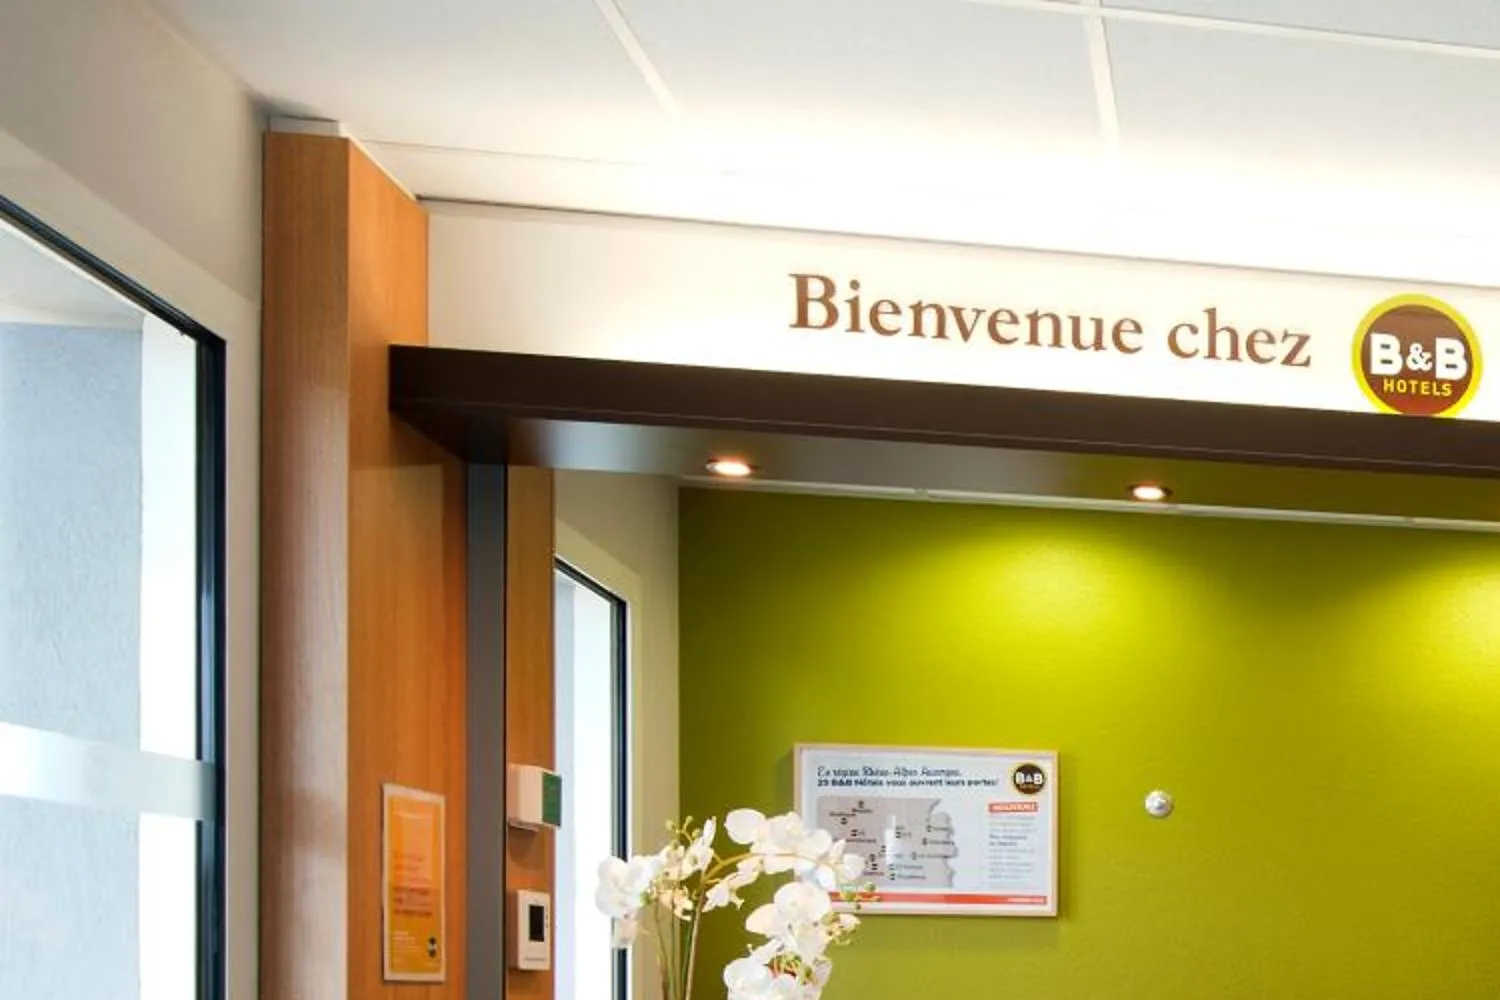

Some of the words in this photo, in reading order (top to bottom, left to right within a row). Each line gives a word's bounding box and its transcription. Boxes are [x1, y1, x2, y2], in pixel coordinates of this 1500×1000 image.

[787, 273, 1144, 355] Bienvenue
[1167, 307, 1312, 368] chez
[1369, 332, 1468, 381] B&B
[1382, 378, 1453, 397] HOTELS
[1015, 771, 1044, 785] B&B
